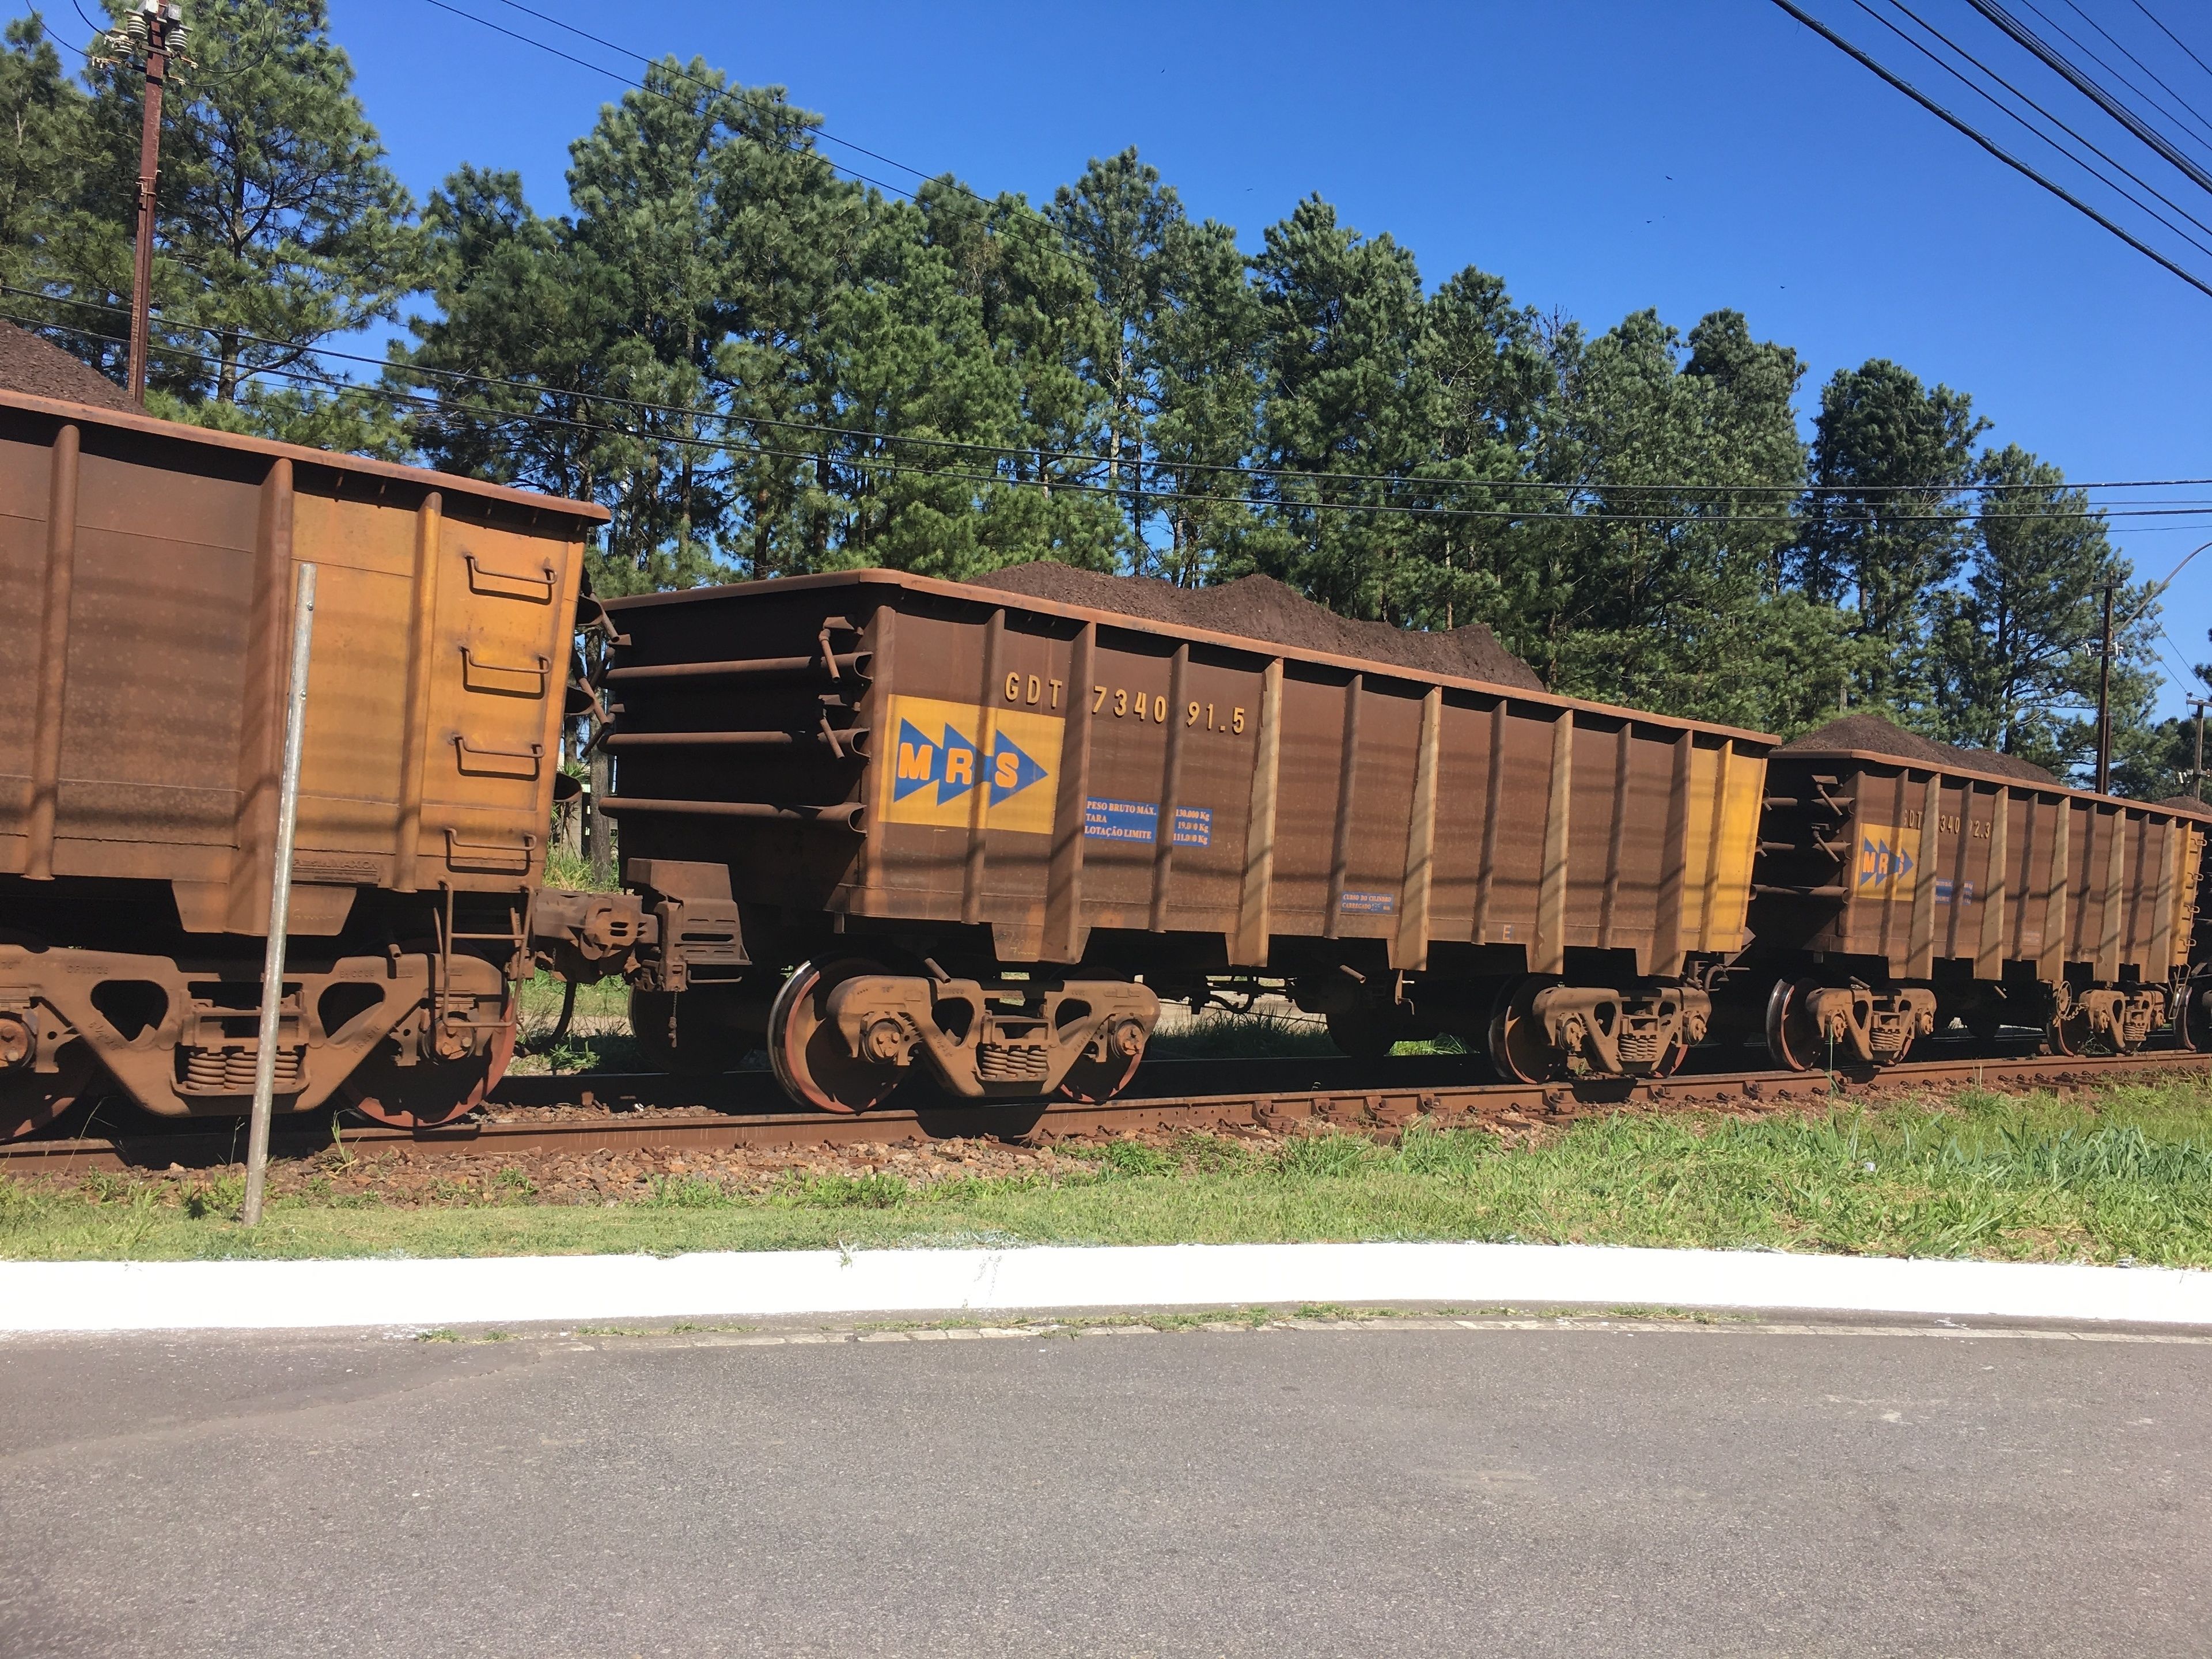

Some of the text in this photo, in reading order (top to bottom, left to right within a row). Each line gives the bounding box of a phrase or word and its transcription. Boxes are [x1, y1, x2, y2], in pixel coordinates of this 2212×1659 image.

[1005, 671, 1062, 707] GDT
[897, 742, 1019, 789] MRS
[1087, 801, 1107, 810] PESO
[1109, 803, 1135, 813] BRUTO
[1137, 804, 1157, 815] MÁX.
[1200, 811, 1210, 822] Kg
[1086, 813, 1107, 823] TARA
[1199, 823, 1209, 834] Kg
[1940, 815, 1960, 834] 340
[1084, 825, 1123, 837] LOTAÇÃO
[1124, 829, 1152, 839] LIMITE
[1198, 835, 1208, 845] Kg
[1863, 851, 1904, 874] MRS
[1502, 925, 1511, 940] E
